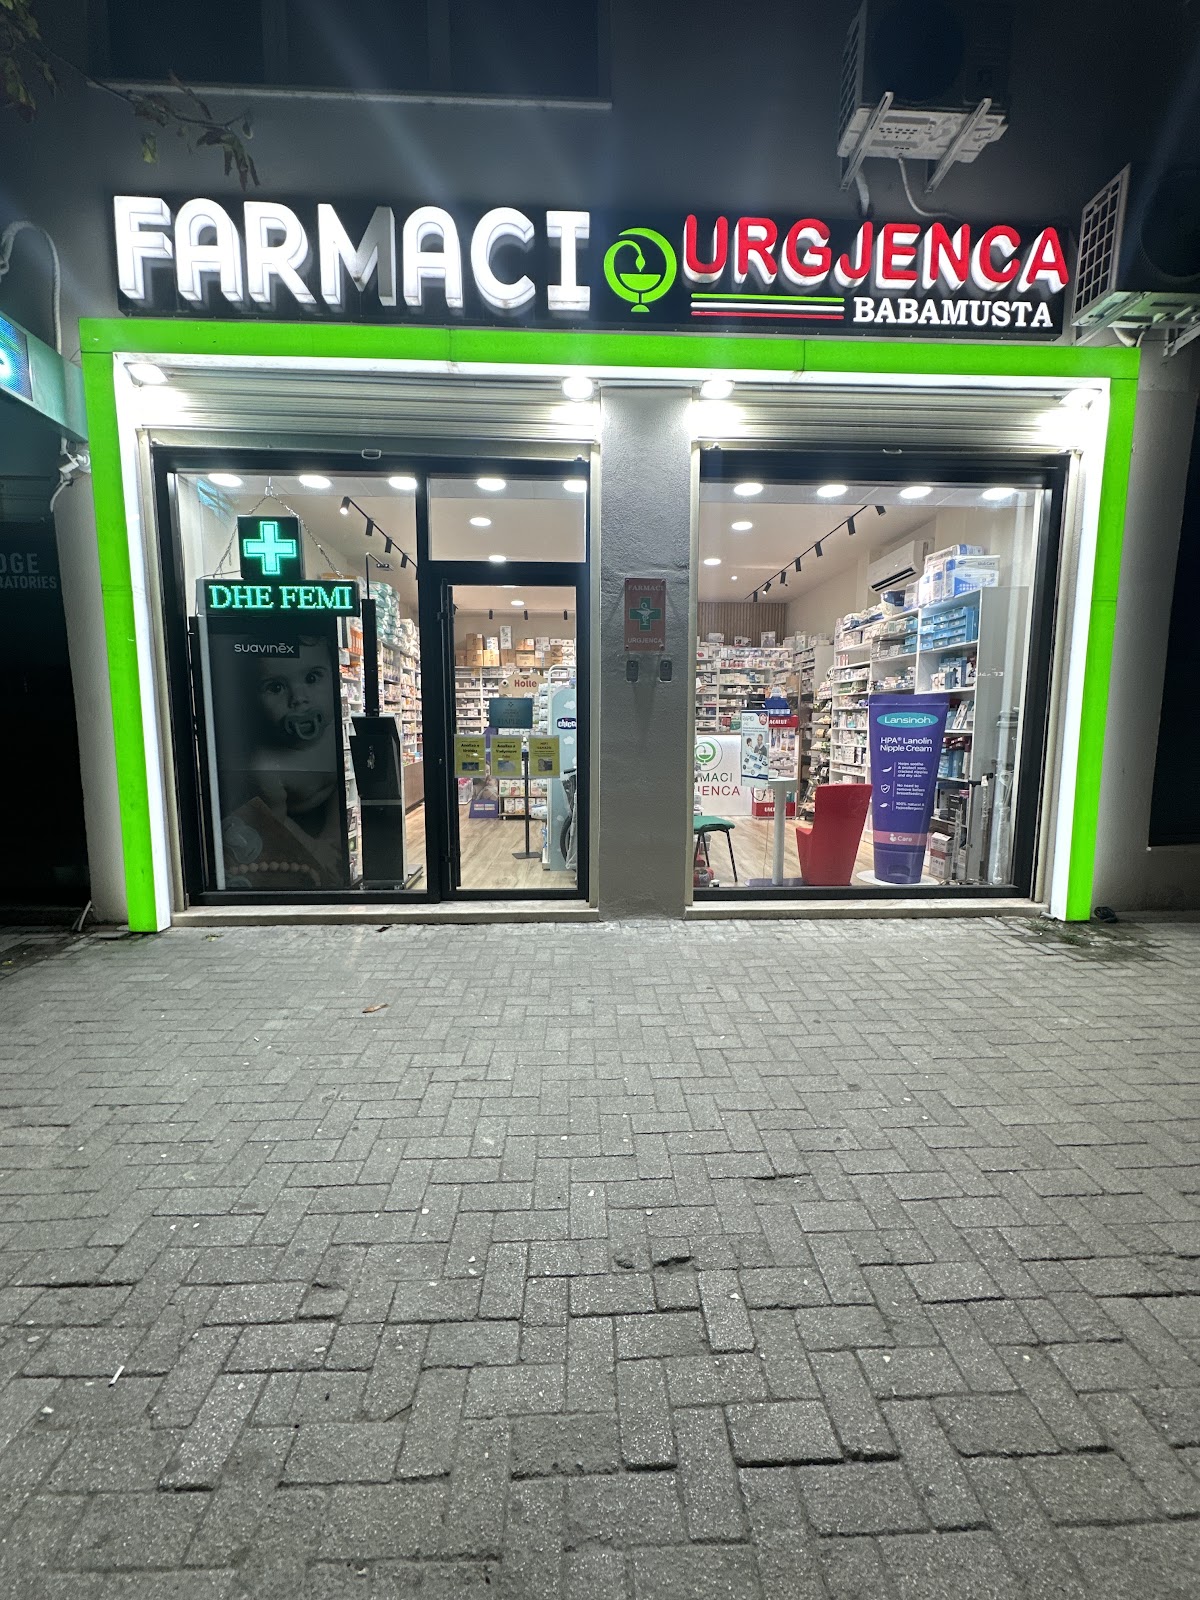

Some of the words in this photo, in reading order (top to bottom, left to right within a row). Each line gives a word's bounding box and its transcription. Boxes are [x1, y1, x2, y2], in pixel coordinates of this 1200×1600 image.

[114, 195, 590, 311] FARMACI
[683, 214, 1069, 292] URGJENCA
[853, 297, 1053, 328] BABAMUSTA
[208, 585, 274, 609] DHE
[279, 586, 353, 610] FEMI
[514, 679, 537, 688] Holle
[884, 716, 931, 724] Lansinoh
[880, 744, 905, 753] Nipple
